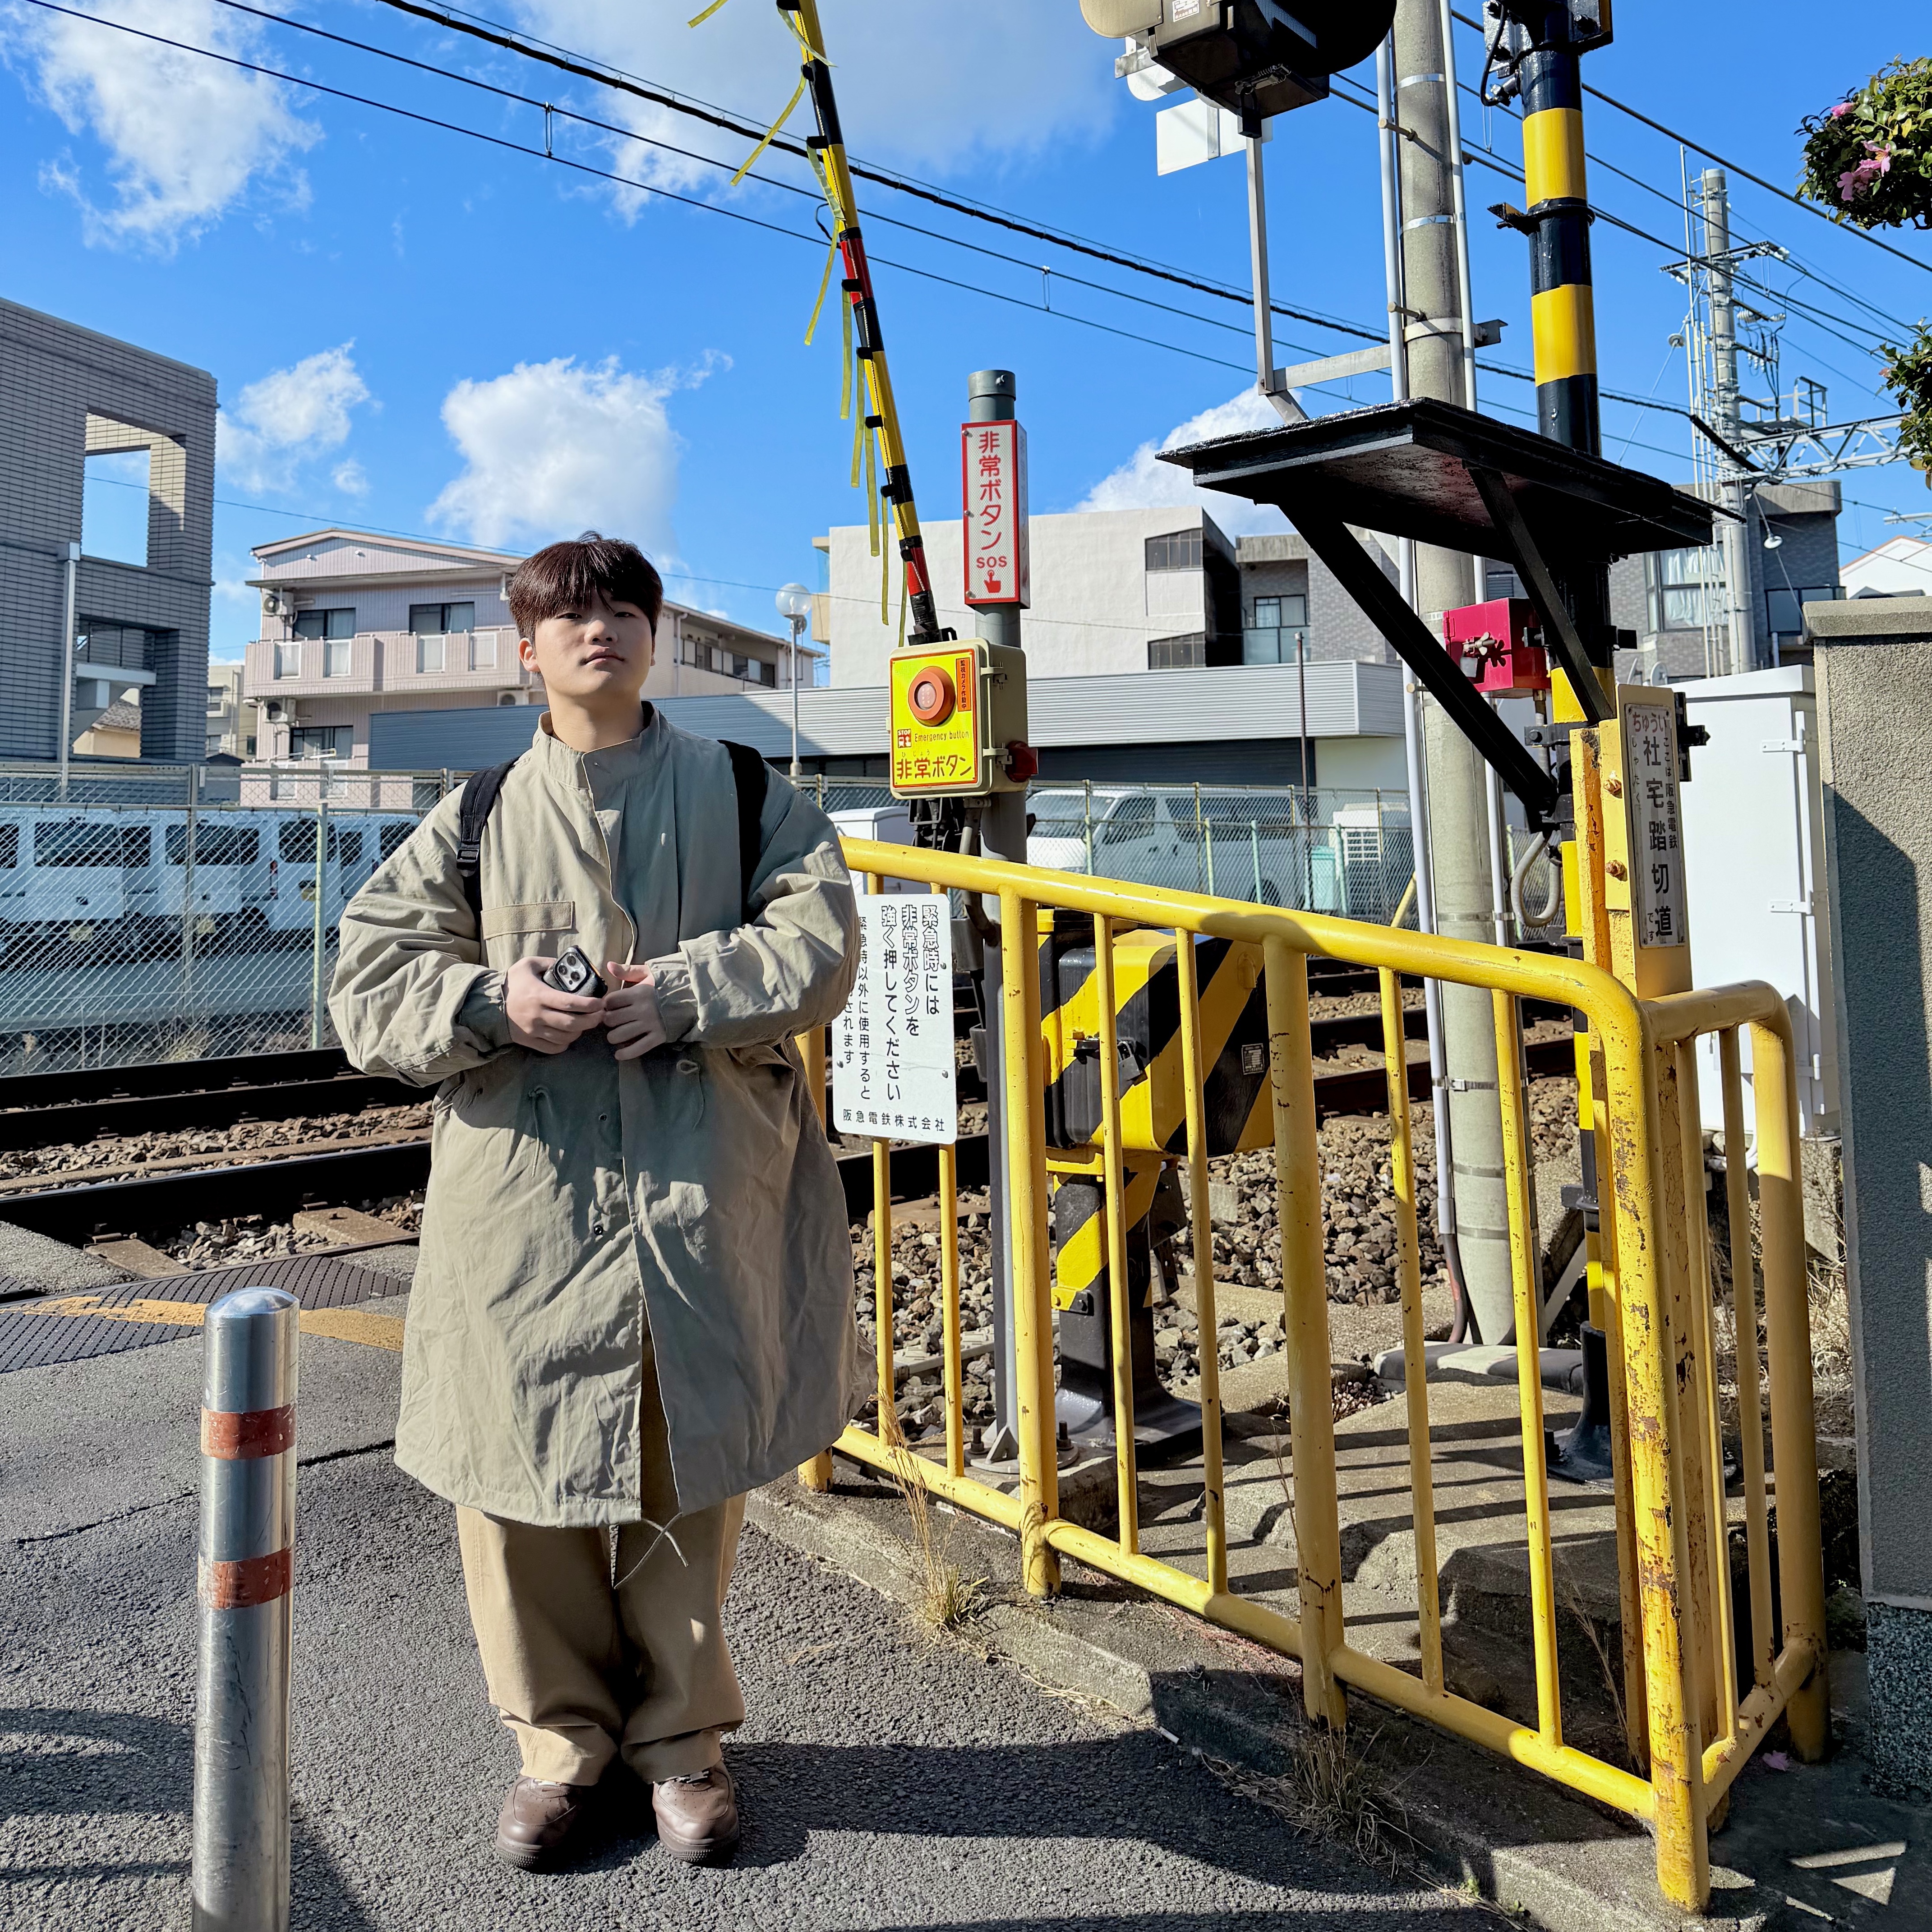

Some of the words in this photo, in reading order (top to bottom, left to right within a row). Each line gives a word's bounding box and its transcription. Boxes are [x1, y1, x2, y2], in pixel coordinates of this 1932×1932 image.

[978, 431, 1002, 550] 非常ボタン
[976, 556, 1007, 569] SOS
[915, 732, 947, 742] Emergency
[950, 730, 969, 739] button
[1632, 712, 1667, 733] ちゅうい
[896, 754, 971, 779] 非常ボタン
[1663, 737, 1678, 849] ここは阪急電鉄
[1643, 736, 1673, 937] 社宅踏切道
[922, 905, 940, 1015] 緊急時には
[1647, 912, 1655, 941] です
[881, 905, 900, 1100] 強く押してください
[902, 904, 919, 1036] 非常ボタンを
[843, 1109, 945, 1132] 阪急電鉄株式会社
